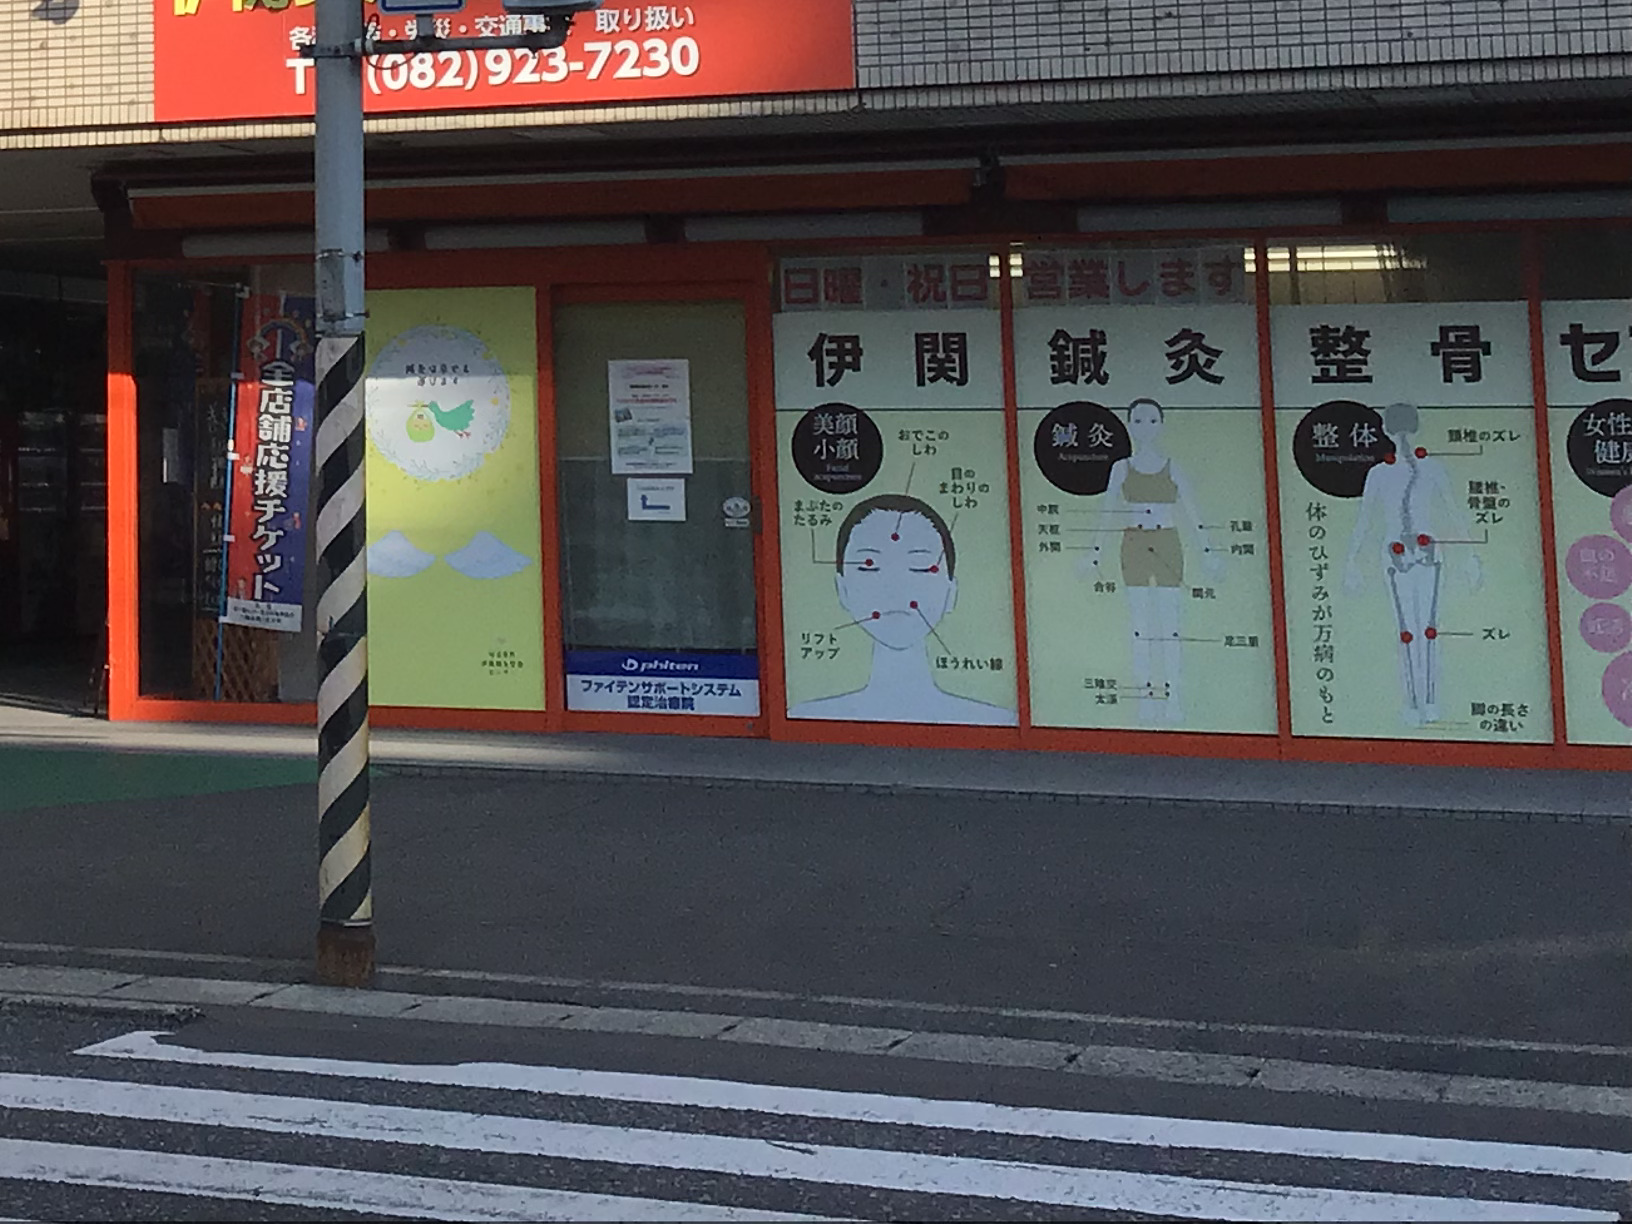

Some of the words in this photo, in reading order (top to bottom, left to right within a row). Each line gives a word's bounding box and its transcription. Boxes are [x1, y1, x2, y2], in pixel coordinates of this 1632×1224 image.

[594, 6, 695, 34] 取り扱い
[807, 331, 969, 388] 伊関
[1047, 327, 1226, 386] 鍼灸
[1309, 324, 1492, 384] 整骨
[813, 412, 859, 436] 美顔
[897, 429, 950, 442] おでこの
[1311, 422, 1379, 449] 整体
[813, 437, 860, 461] 小顔
[911, 443, 937, 456] しわ
[253, 360, 294, 602] 全店舗応援チケット
[950, 467, 976, 481] 目の
[939, 482, 991, 495] まわりの
[793, 499, 844, 512] まぶたの
[952, 496, 978, 509] しわ
[793, 514, 833, 527] たるみ
[1475, 511, 1504, 525] ズレ
[1305, 501, 1335, 725] 体のひずみが万病のもと
[800, 632, 838, 646] リフト
[1482, 627, 1511, 641] ズレ
[800, 646, 841, 660] アップ
[640, 659, 700, 672] phiten
[580, 679, 742, 698] ファイテンサポートシステム
